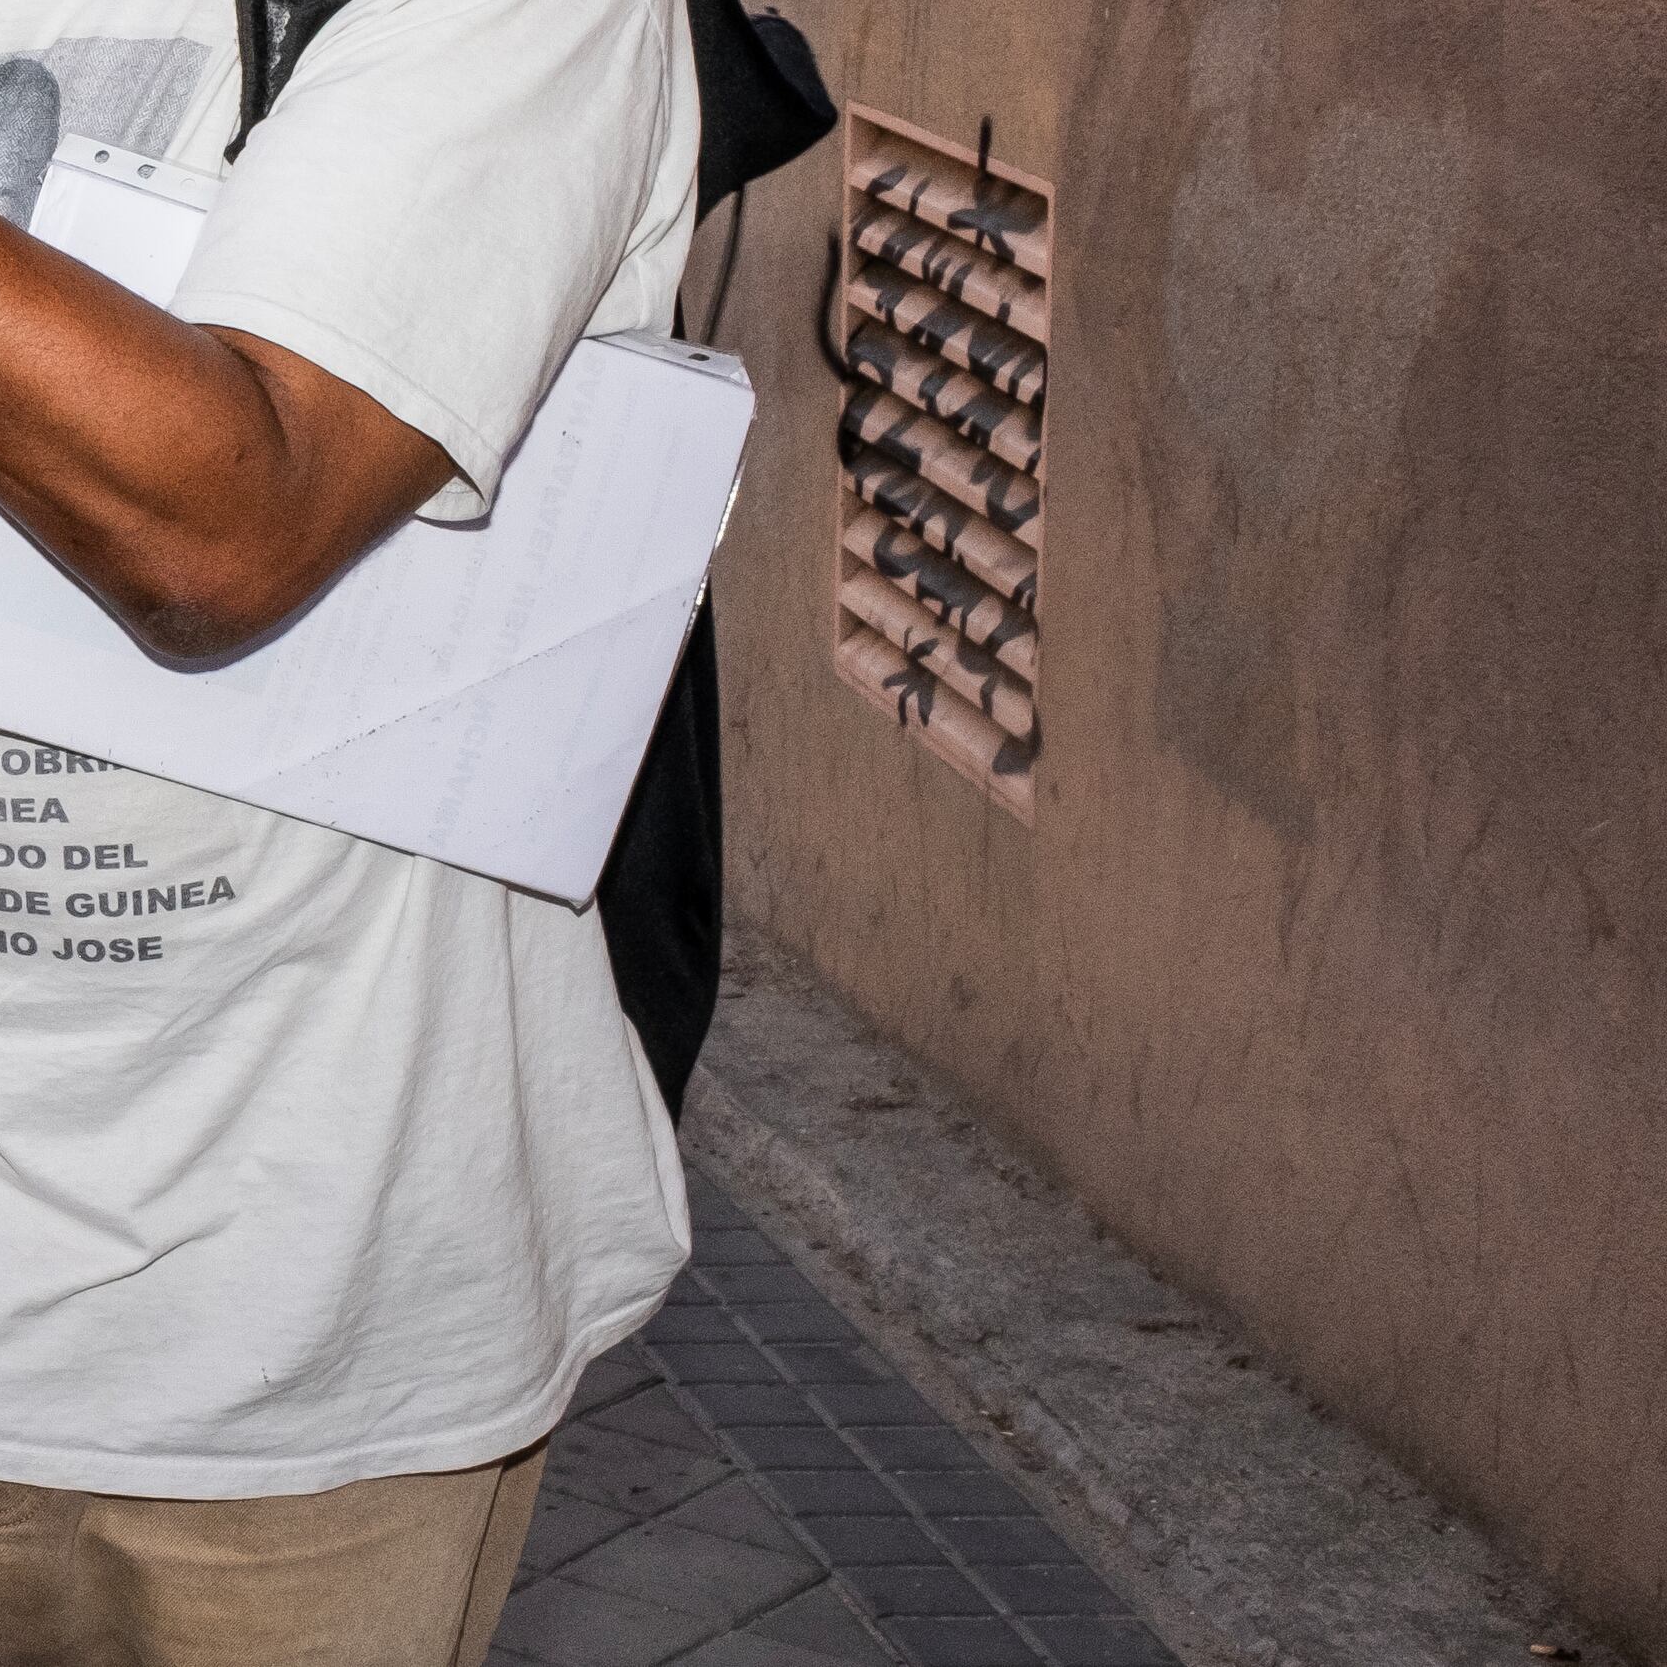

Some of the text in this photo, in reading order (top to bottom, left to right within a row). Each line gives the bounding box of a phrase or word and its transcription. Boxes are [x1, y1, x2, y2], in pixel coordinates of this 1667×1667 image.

[63, 843, 148, 870] DEL
[66, 876, 236, 918] GUINEA
[52, 936, 163, 963] JOSE
